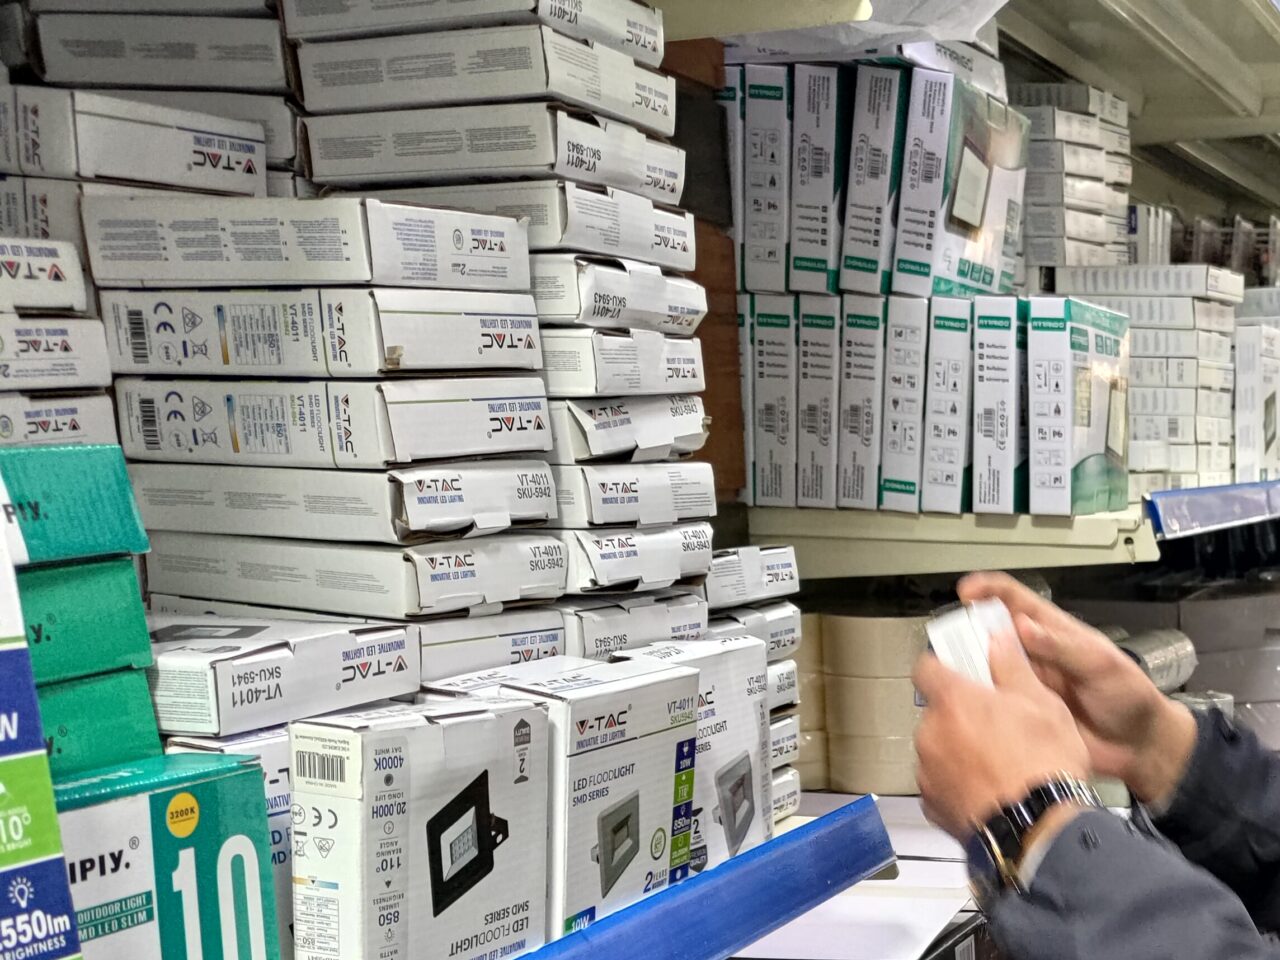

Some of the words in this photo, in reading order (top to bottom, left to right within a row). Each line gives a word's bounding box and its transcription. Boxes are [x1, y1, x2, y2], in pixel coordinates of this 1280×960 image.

[192, 150, 257, 175] V-TAC
[482, 333, 536, 349] V-TAC
[587, 405, 628, 420] V-TAC
[490, 415, 545, 432] V-TAC
[415, 479, 462, 493] V-TAC
[517, 473, 549, 486] VT-4011
[517, 487, 551, 499] SKU-5942
[599, 482, 638, 494] V-TAC
[592, 536, 636, 550] V-TAC
[530, 545, 562, 558] VT-4011
[425, 554, 475, 570] V-TAC
[530, 558, 563, 571] SKU-5942
[231, 665, 282, 686] SKU-5941
[342, 655, 408, 683] V-TAC
[231, 683, 283, 708] VT-4011
[667, 698, 694, 714] VT-4011
[576, 708, 627, 735] V-TAC
[374, 756, 404, 772] 4000K
[573, 775, 587, 792] LED
[588, 763, 635, 788] FLOODLIGHT
[572, 793, 587, 807] SMD
[588, 787, 609, 804] SERIES
[169, 807, 195, 820] 3200K
[372, 801, 406, 819] 20,000H
[77, 902, 120, 924] OUTDOOR
[122, 894, 147, 911] LIGHT
[485, 907, 510, 925] SERIES
[512, 901, 529, 915] SMD
[98, 919, 118, 935] LED
[121, 911, 147, 928] SLIM
[379, 910, 400, 926] 850
[513, 917, 529, 933] LED
[449, 924, 510, 957] FLOODLIGHT
